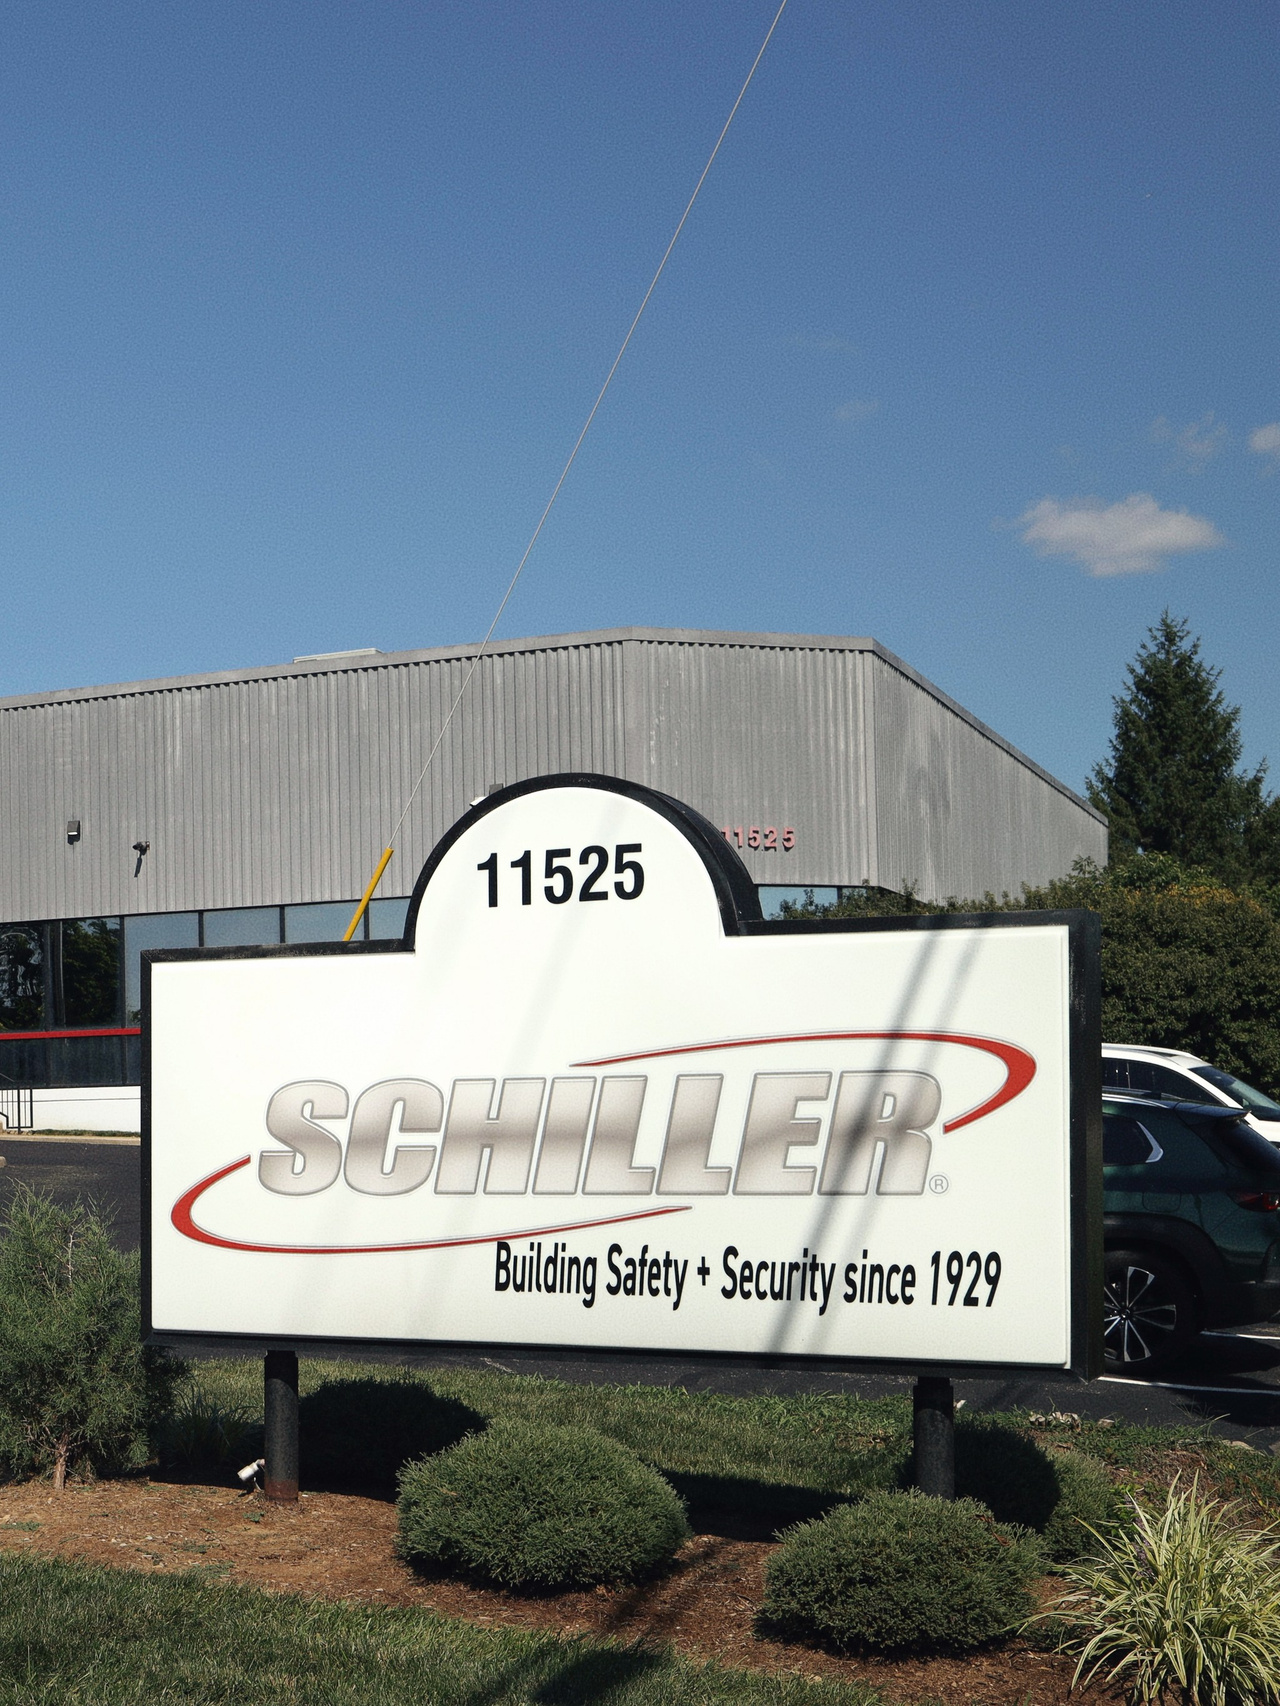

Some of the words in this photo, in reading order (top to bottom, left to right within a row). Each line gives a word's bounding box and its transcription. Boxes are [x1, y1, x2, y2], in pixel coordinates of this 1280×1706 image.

[477, 843, 645, 908] 11525
[257, 1070, 943, 1197] SCHILLER
[494, 1241, 598, 1309] Building
[605, 1243, 689, 1311] Safety
[697, 1256, 711, 1286] +
[720, 1245, 837, 1317] Security
[843, 1249, 916, 1306] since
[930, 1250, 1002, 1308] 1929
